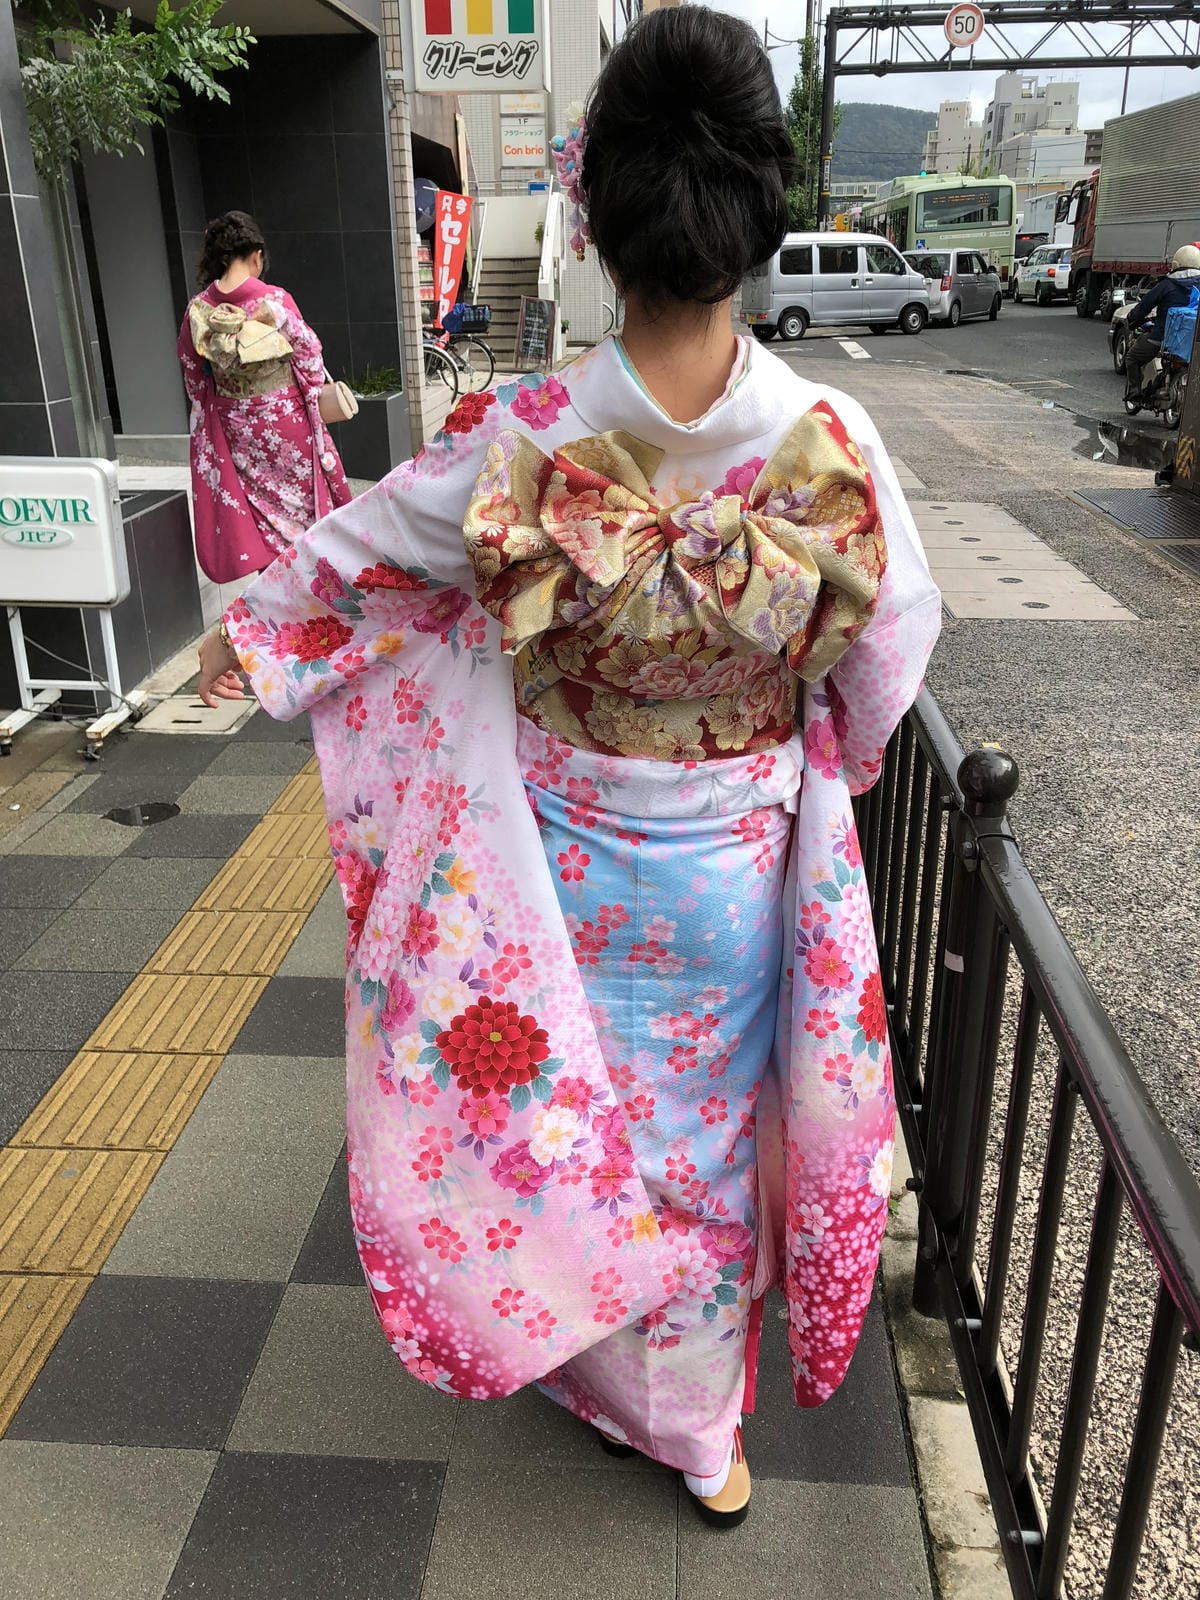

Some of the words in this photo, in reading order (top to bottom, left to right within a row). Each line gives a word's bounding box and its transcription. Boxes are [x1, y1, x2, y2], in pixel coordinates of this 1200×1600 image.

[954, 15, 976, 34] 50
[424, 40, 539, 79] クリーニング
[503, 129, 543, 137] フラワーショップ
[503, 144, 523, 155] Con
[525, 144, 545, 155] brio
[16, 530, 57, 543] ノエビア
